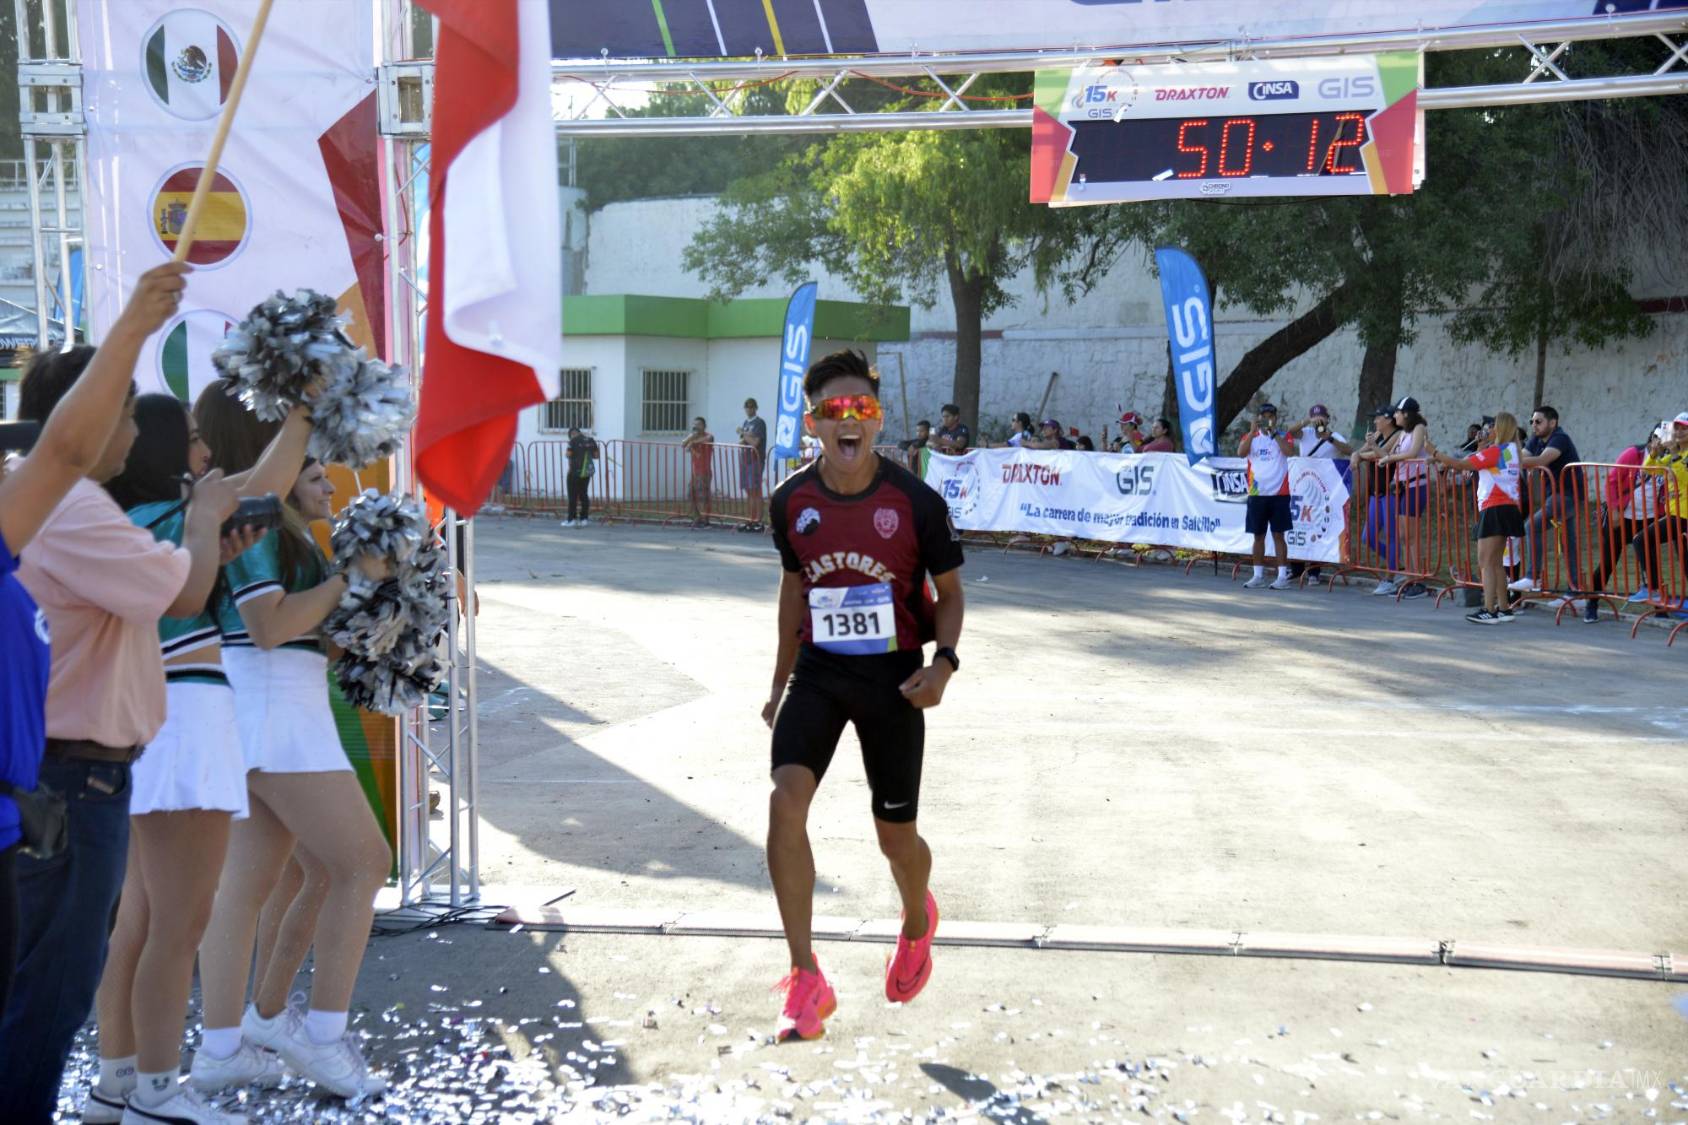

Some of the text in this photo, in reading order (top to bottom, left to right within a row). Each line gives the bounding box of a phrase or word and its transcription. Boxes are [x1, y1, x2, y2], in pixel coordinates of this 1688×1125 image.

[1085, 86, 1118, 103] 15K
[1155, 87, 1230, 101] DRAXTON
[1318, 76, 1375, 99] GIS
[1088, 108, 1113, 118] GIS
[1172, 296, 1213, 412] GIS
[781, 324, 808, 412] GIS
[1116, 465, 1154, 496] GIS
[1043, 507, 1076, 522] carrera
[1077, 508, 1091, 522] de
[1290, 495, 1312, 522] 5K
[1286, 530, 1307, 546] GIS
[822, 611, 881, 637] 1381
